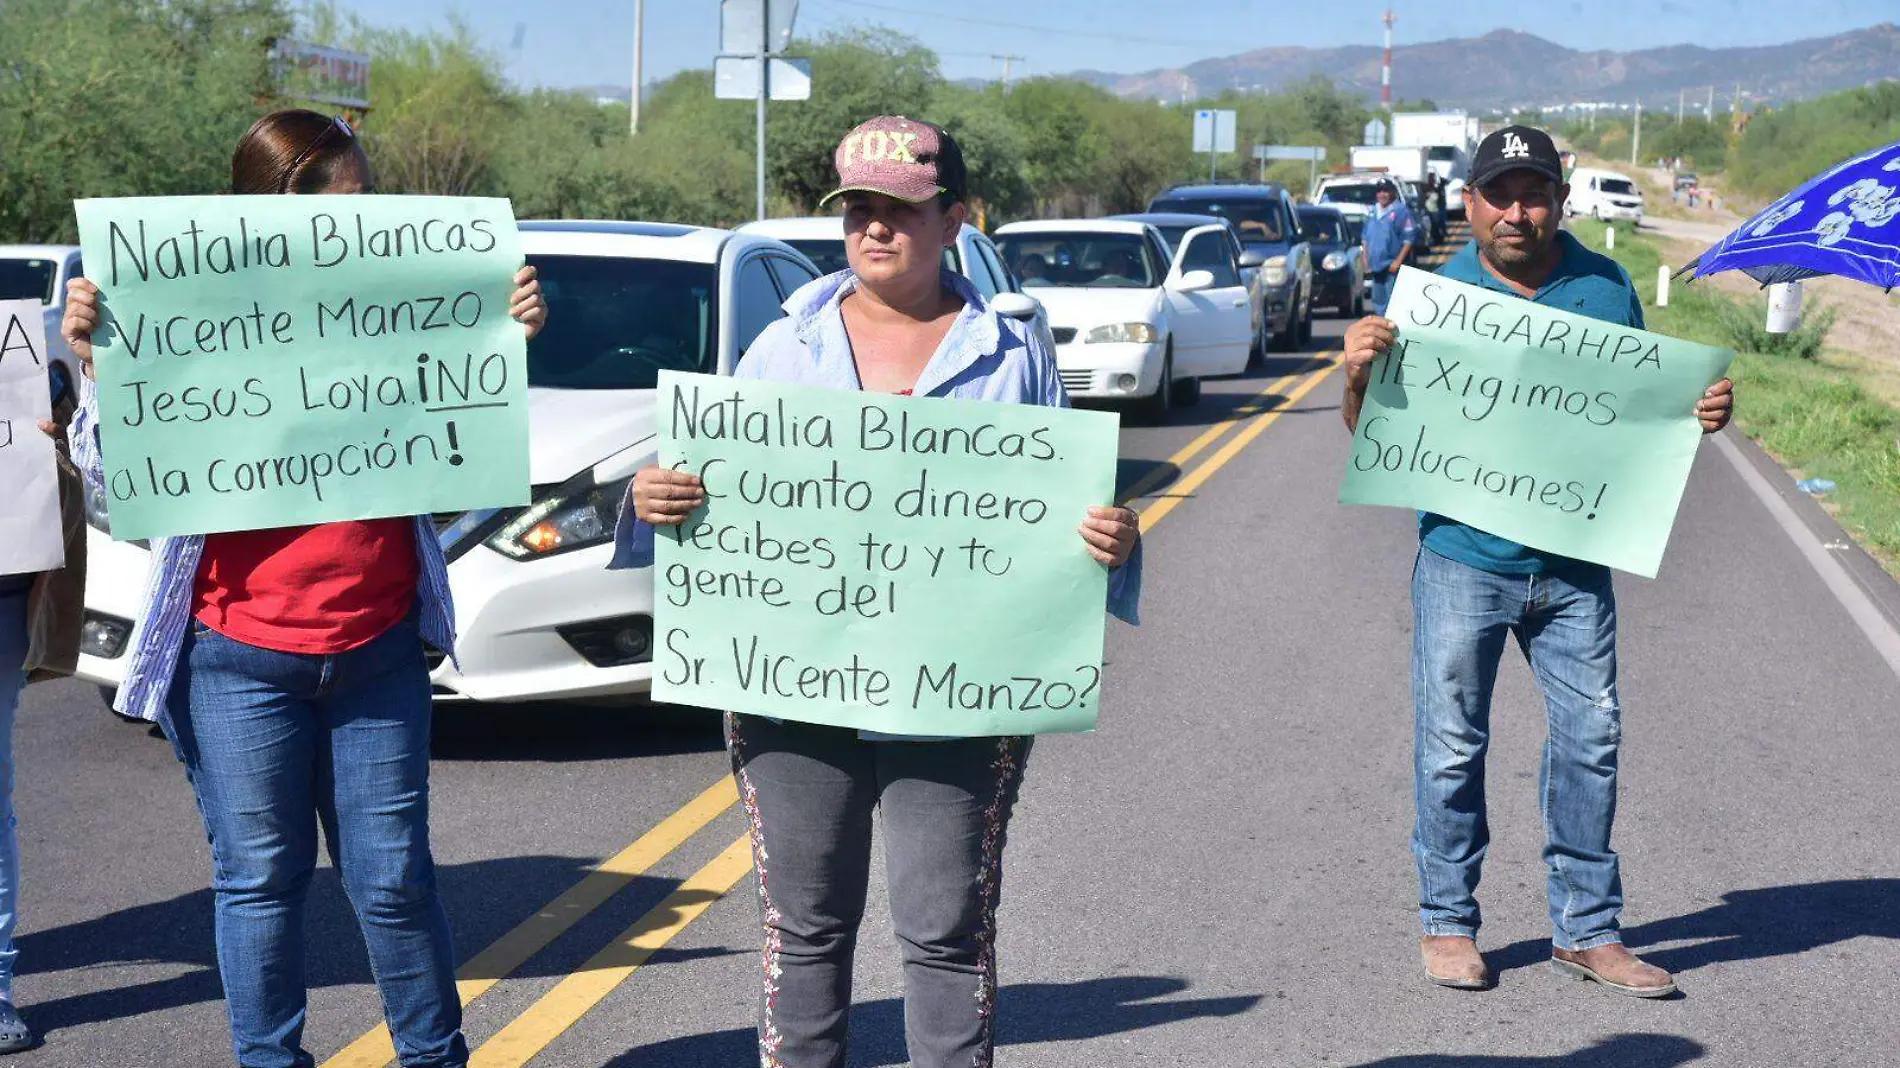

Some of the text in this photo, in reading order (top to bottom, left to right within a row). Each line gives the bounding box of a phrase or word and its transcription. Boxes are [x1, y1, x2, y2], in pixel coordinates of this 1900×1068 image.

[843, 130, 917, 168] FOX
[1501, 132, 1530, 159] LA
[109, 212, 496, 288] Natalia Blancas
[113, 290, 482, 359] Vicente Manzo
[1410, 283, 1661, 370] SAGARHPA
[121, 377, 272, 427] Jesus
[672, 384, 834, 449] Natalia
[112, 468, 138, 501] a
[147, 456, 191, 497] la
[894, 468, 1048, 525] dinero
[1355, 415, 1608, 521] Soluciones!
[859, 532, 908, 572] tu
[924, 546, 945, 578] y
[666, 563, 896, 619] gente del
[664, 628, 1100, 712] Sr. Vicente Manzo?
